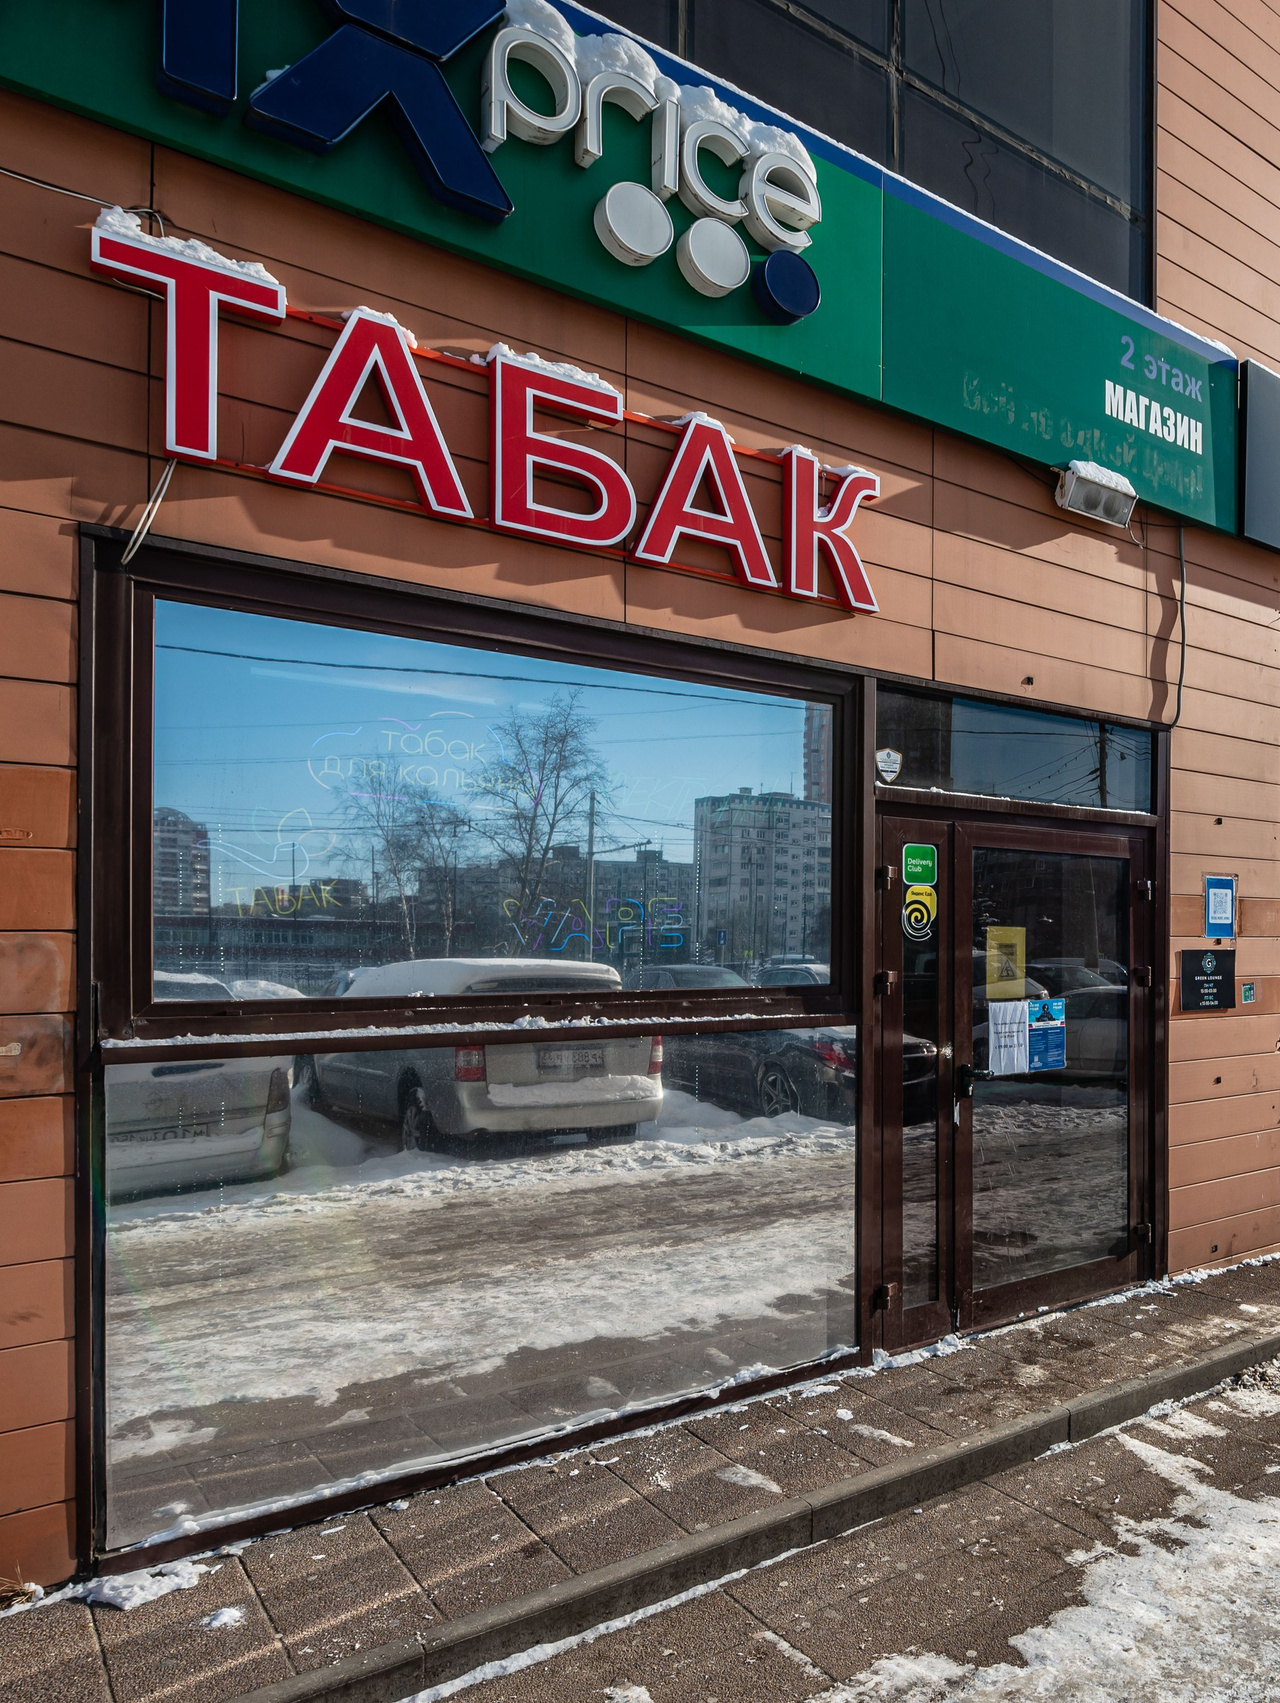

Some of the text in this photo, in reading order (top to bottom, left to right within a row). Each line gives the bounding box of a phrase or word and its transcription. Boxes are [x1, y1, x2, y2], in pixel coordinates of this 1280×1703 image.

[481, 26, 822, 253] price
[1121, 335, 1203, 403] 2 этаж
[90, 227, 880, 614] ТАБАК
[1104, 379, 1203, 455] МАГАЗИН
[319, 754, 538, 798] для кальяна
[907, 858, 933, 867] Delivery
[226, 880, 342, 918] ТАБАК
[502, 896, 684, 952] VAPE
